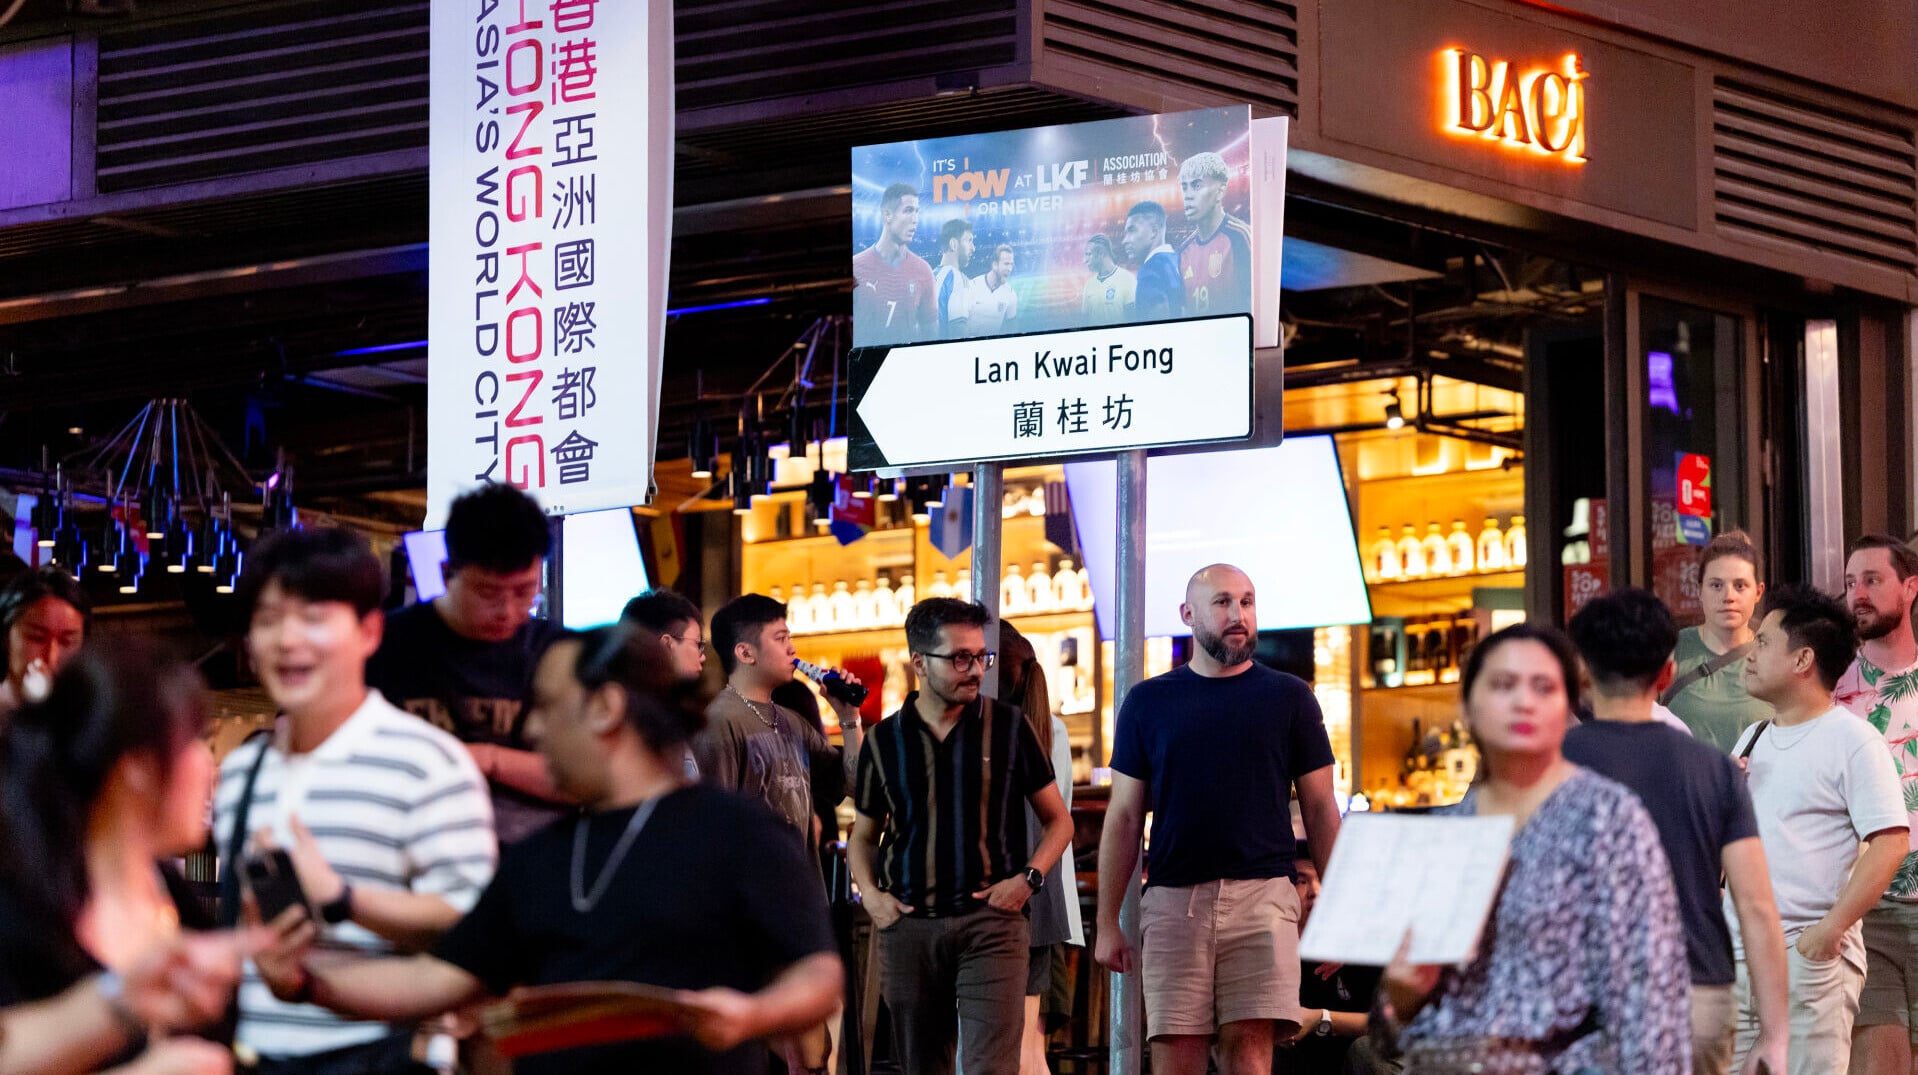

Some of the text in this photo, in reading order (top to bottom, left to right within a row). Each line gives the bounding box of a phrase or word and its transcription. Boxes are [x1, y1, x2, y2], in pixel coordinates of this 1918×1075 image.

[933, 159, 956, 172] IT'S
[1103, 152, 1168, 171] ASSOCIATION
[933, 160, 1089, 204] now AT LKF
[978, 195, 1063, 216] OR NEVER
[475, 0, 500, 486] ASIA'S WORLD CITY
[504, 0, 546, 490] HONG KONG
[885, 301, 897, 328] 7
[975, 344, 1173, 384] Lan Kwai Fong
[1012, 393, 1134, 439] 蘭桂坊
